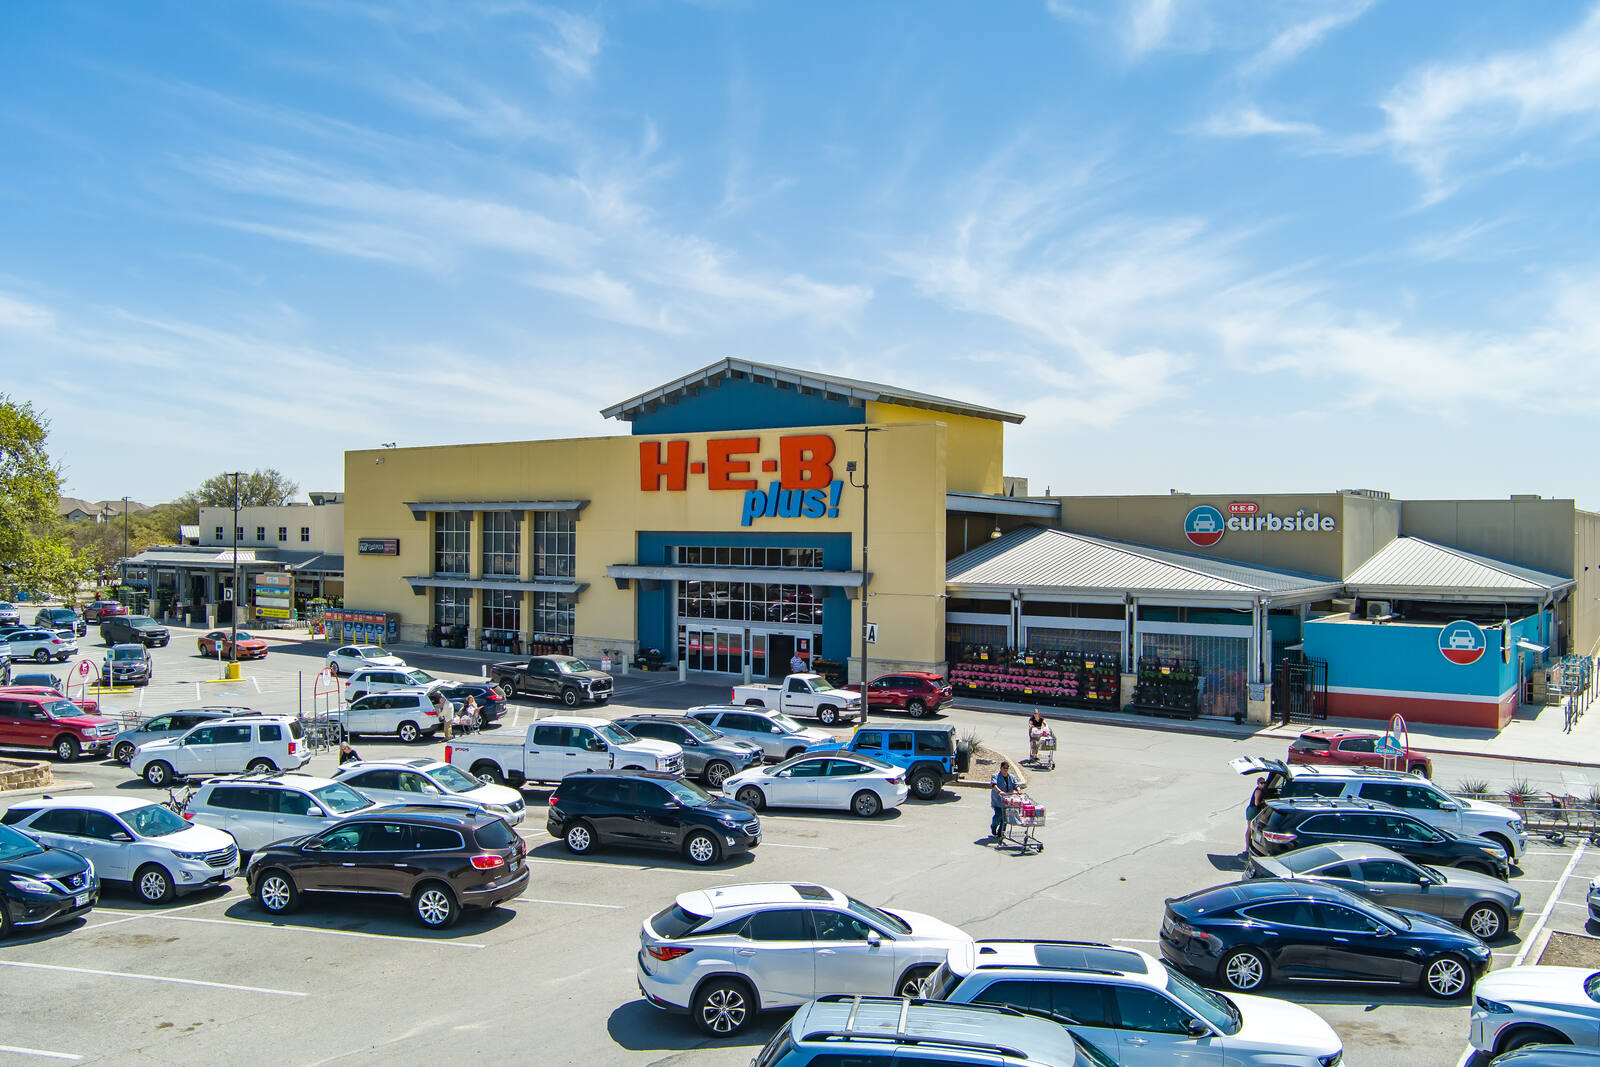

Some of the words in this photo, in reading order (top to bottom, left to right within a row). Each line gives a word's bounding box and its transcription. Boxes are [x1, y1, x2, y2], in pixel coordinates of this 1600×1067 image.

[639, 434, 835, 490] H-E-B
[741, 481, 844, 526] plus!
[1227, 510, 1335, 531] curbside
[226, 590, 231, 599] D
[868, 626, 875, 641] A
